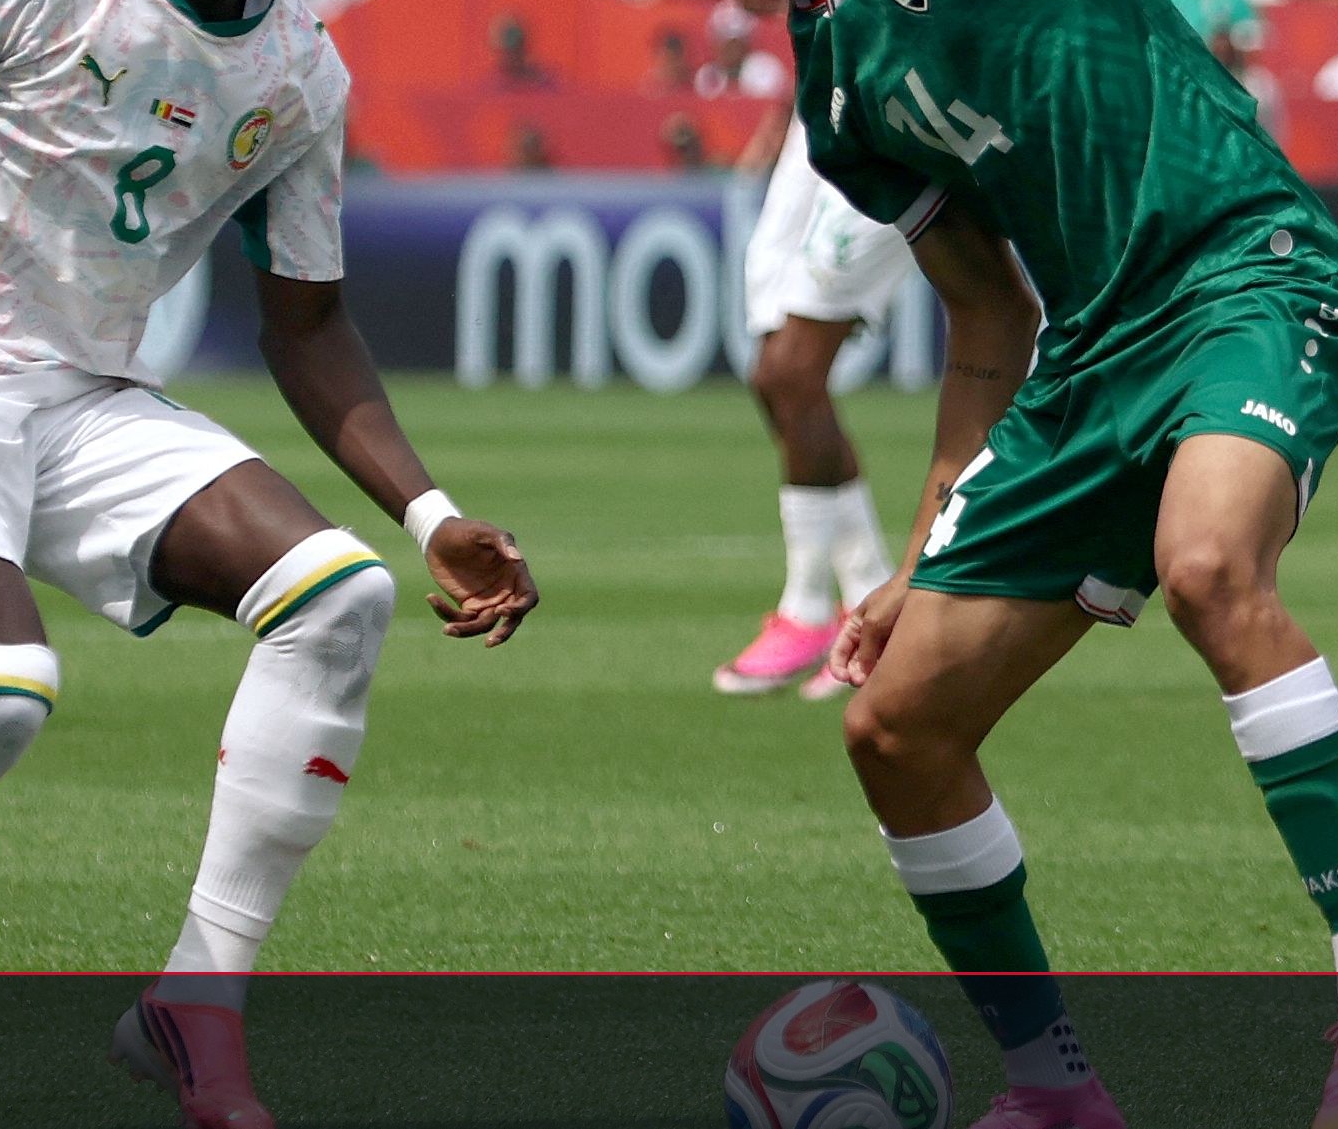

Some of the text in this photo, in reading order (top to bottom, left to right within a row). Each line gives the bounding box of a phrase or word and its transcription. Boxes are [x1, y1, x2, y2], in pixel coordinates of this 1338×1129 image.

[884, 66, 1015, 167] 14
[108, 145, 177, 245] 8
[1240, 399, 1297, 437] JAKO
